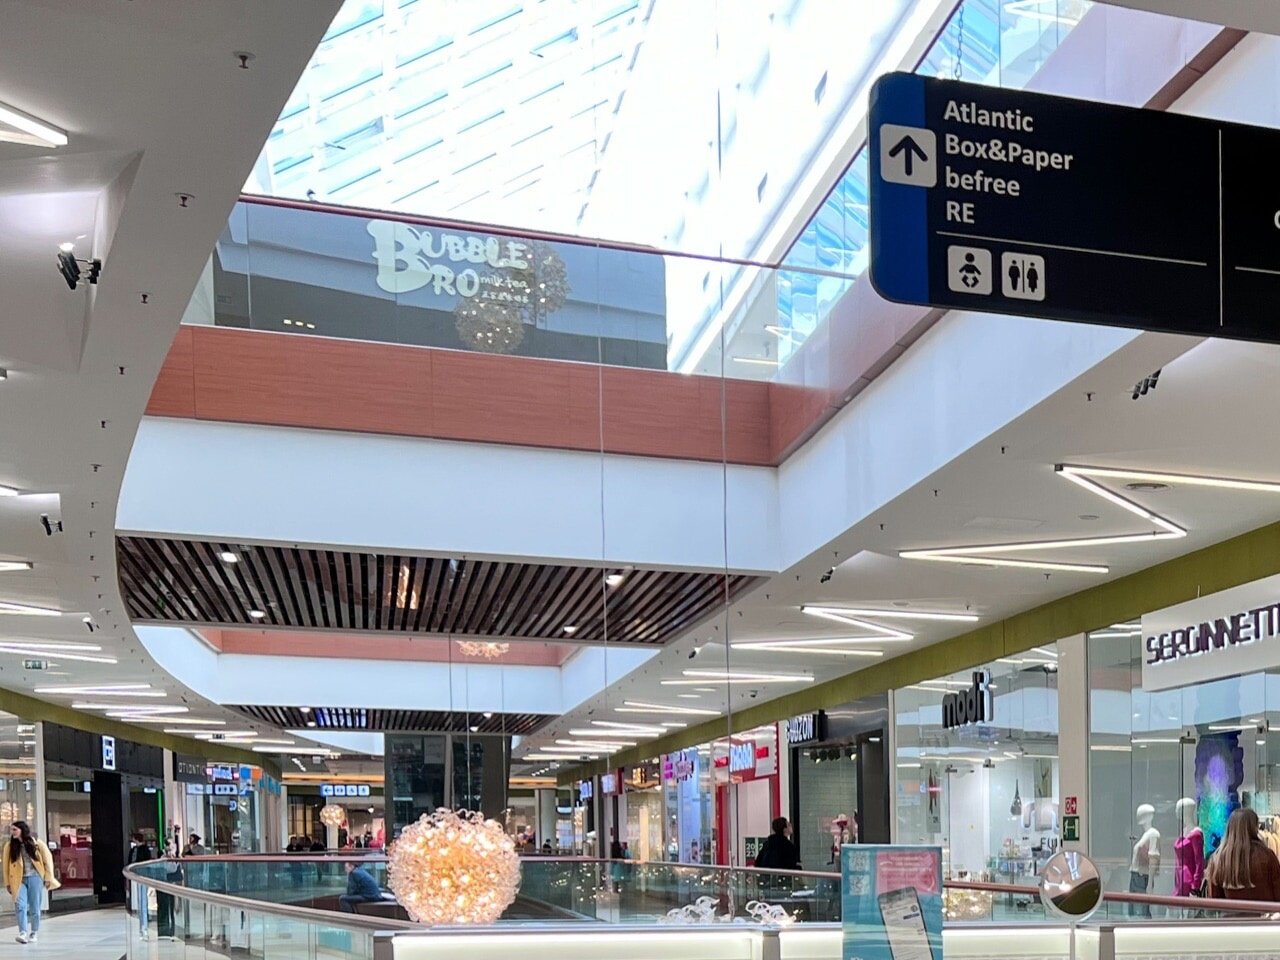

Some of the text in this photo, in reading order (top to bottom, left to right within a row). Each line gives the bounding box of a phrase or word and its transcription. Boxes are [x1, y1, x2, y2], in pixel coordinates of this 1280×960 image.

[944, 100, 1033, 132] Atlantic
[945, 133, 1074, 171] Box&Paper
[945, 166, 1020, 197] befree
[946, 201, 975, 224] RE
